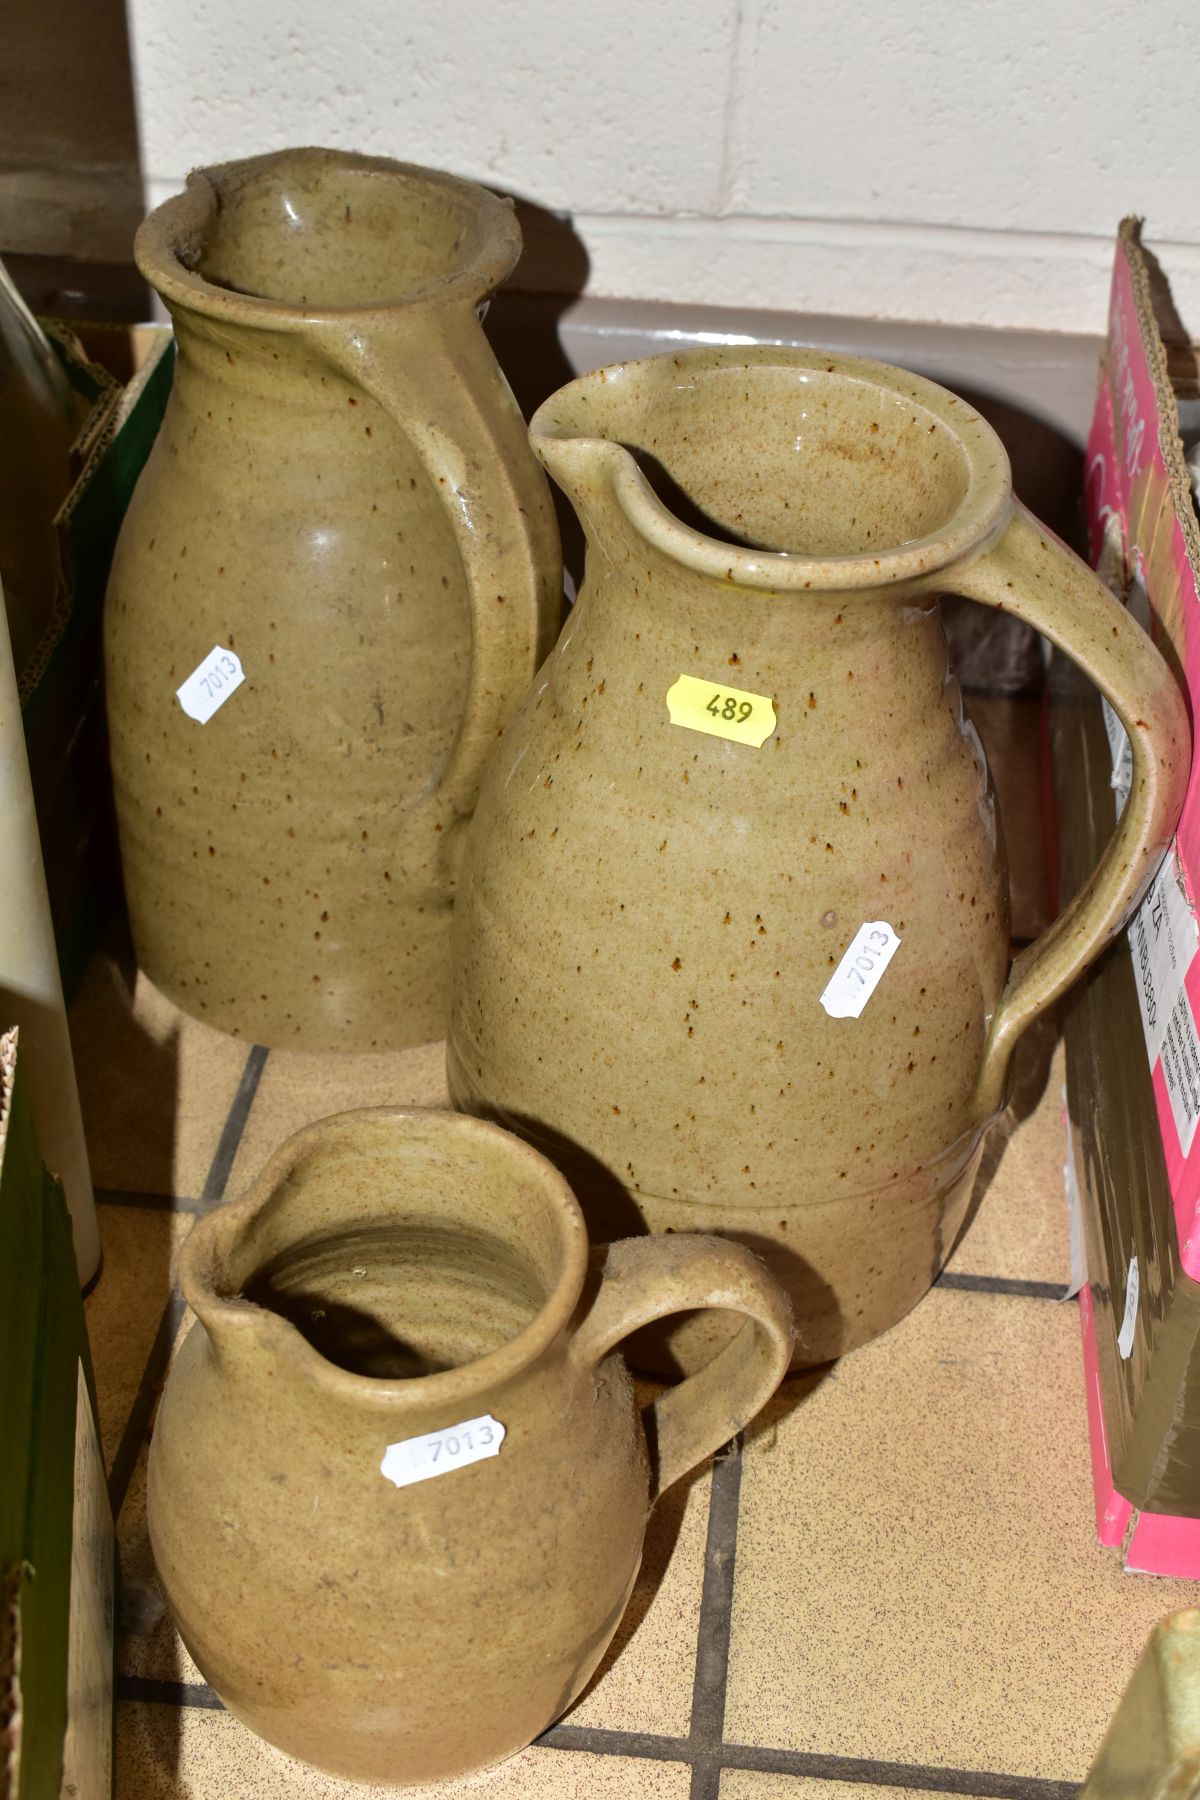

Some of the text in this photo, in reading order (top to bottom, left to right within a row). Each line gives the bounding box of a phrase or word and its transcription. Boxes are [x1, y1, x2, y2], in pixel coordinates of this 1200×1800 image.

[199, 655, 238, 699] 7013
[705, 693, 754, 725] 489
[846, 930, 890, 986] 7013
[427, 1424, 496, 1463] 7013
